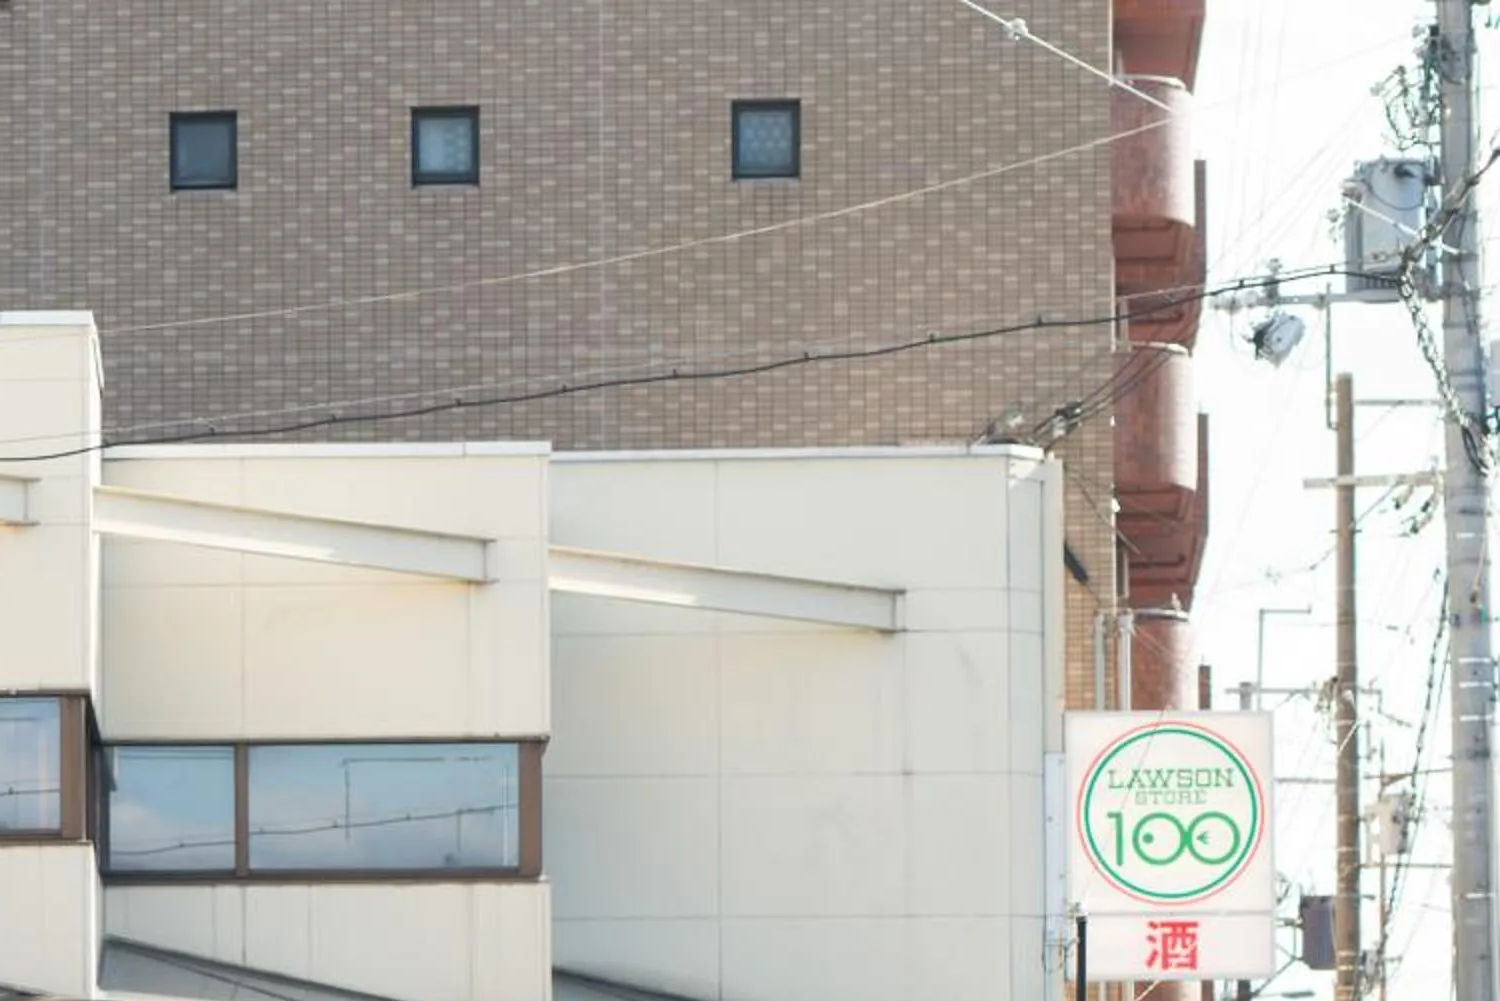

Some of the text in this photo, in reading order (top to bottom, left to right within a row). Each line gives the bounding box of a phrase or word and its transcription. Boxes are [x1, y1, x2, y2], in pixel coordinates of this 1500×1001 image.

[1107, 768, 1235, 789] LAWSON
[1134, 790, 1208, 806] STORE
[1107, 811, 1241, 867] 100
[1146, 921, 1199, 970] 酒
